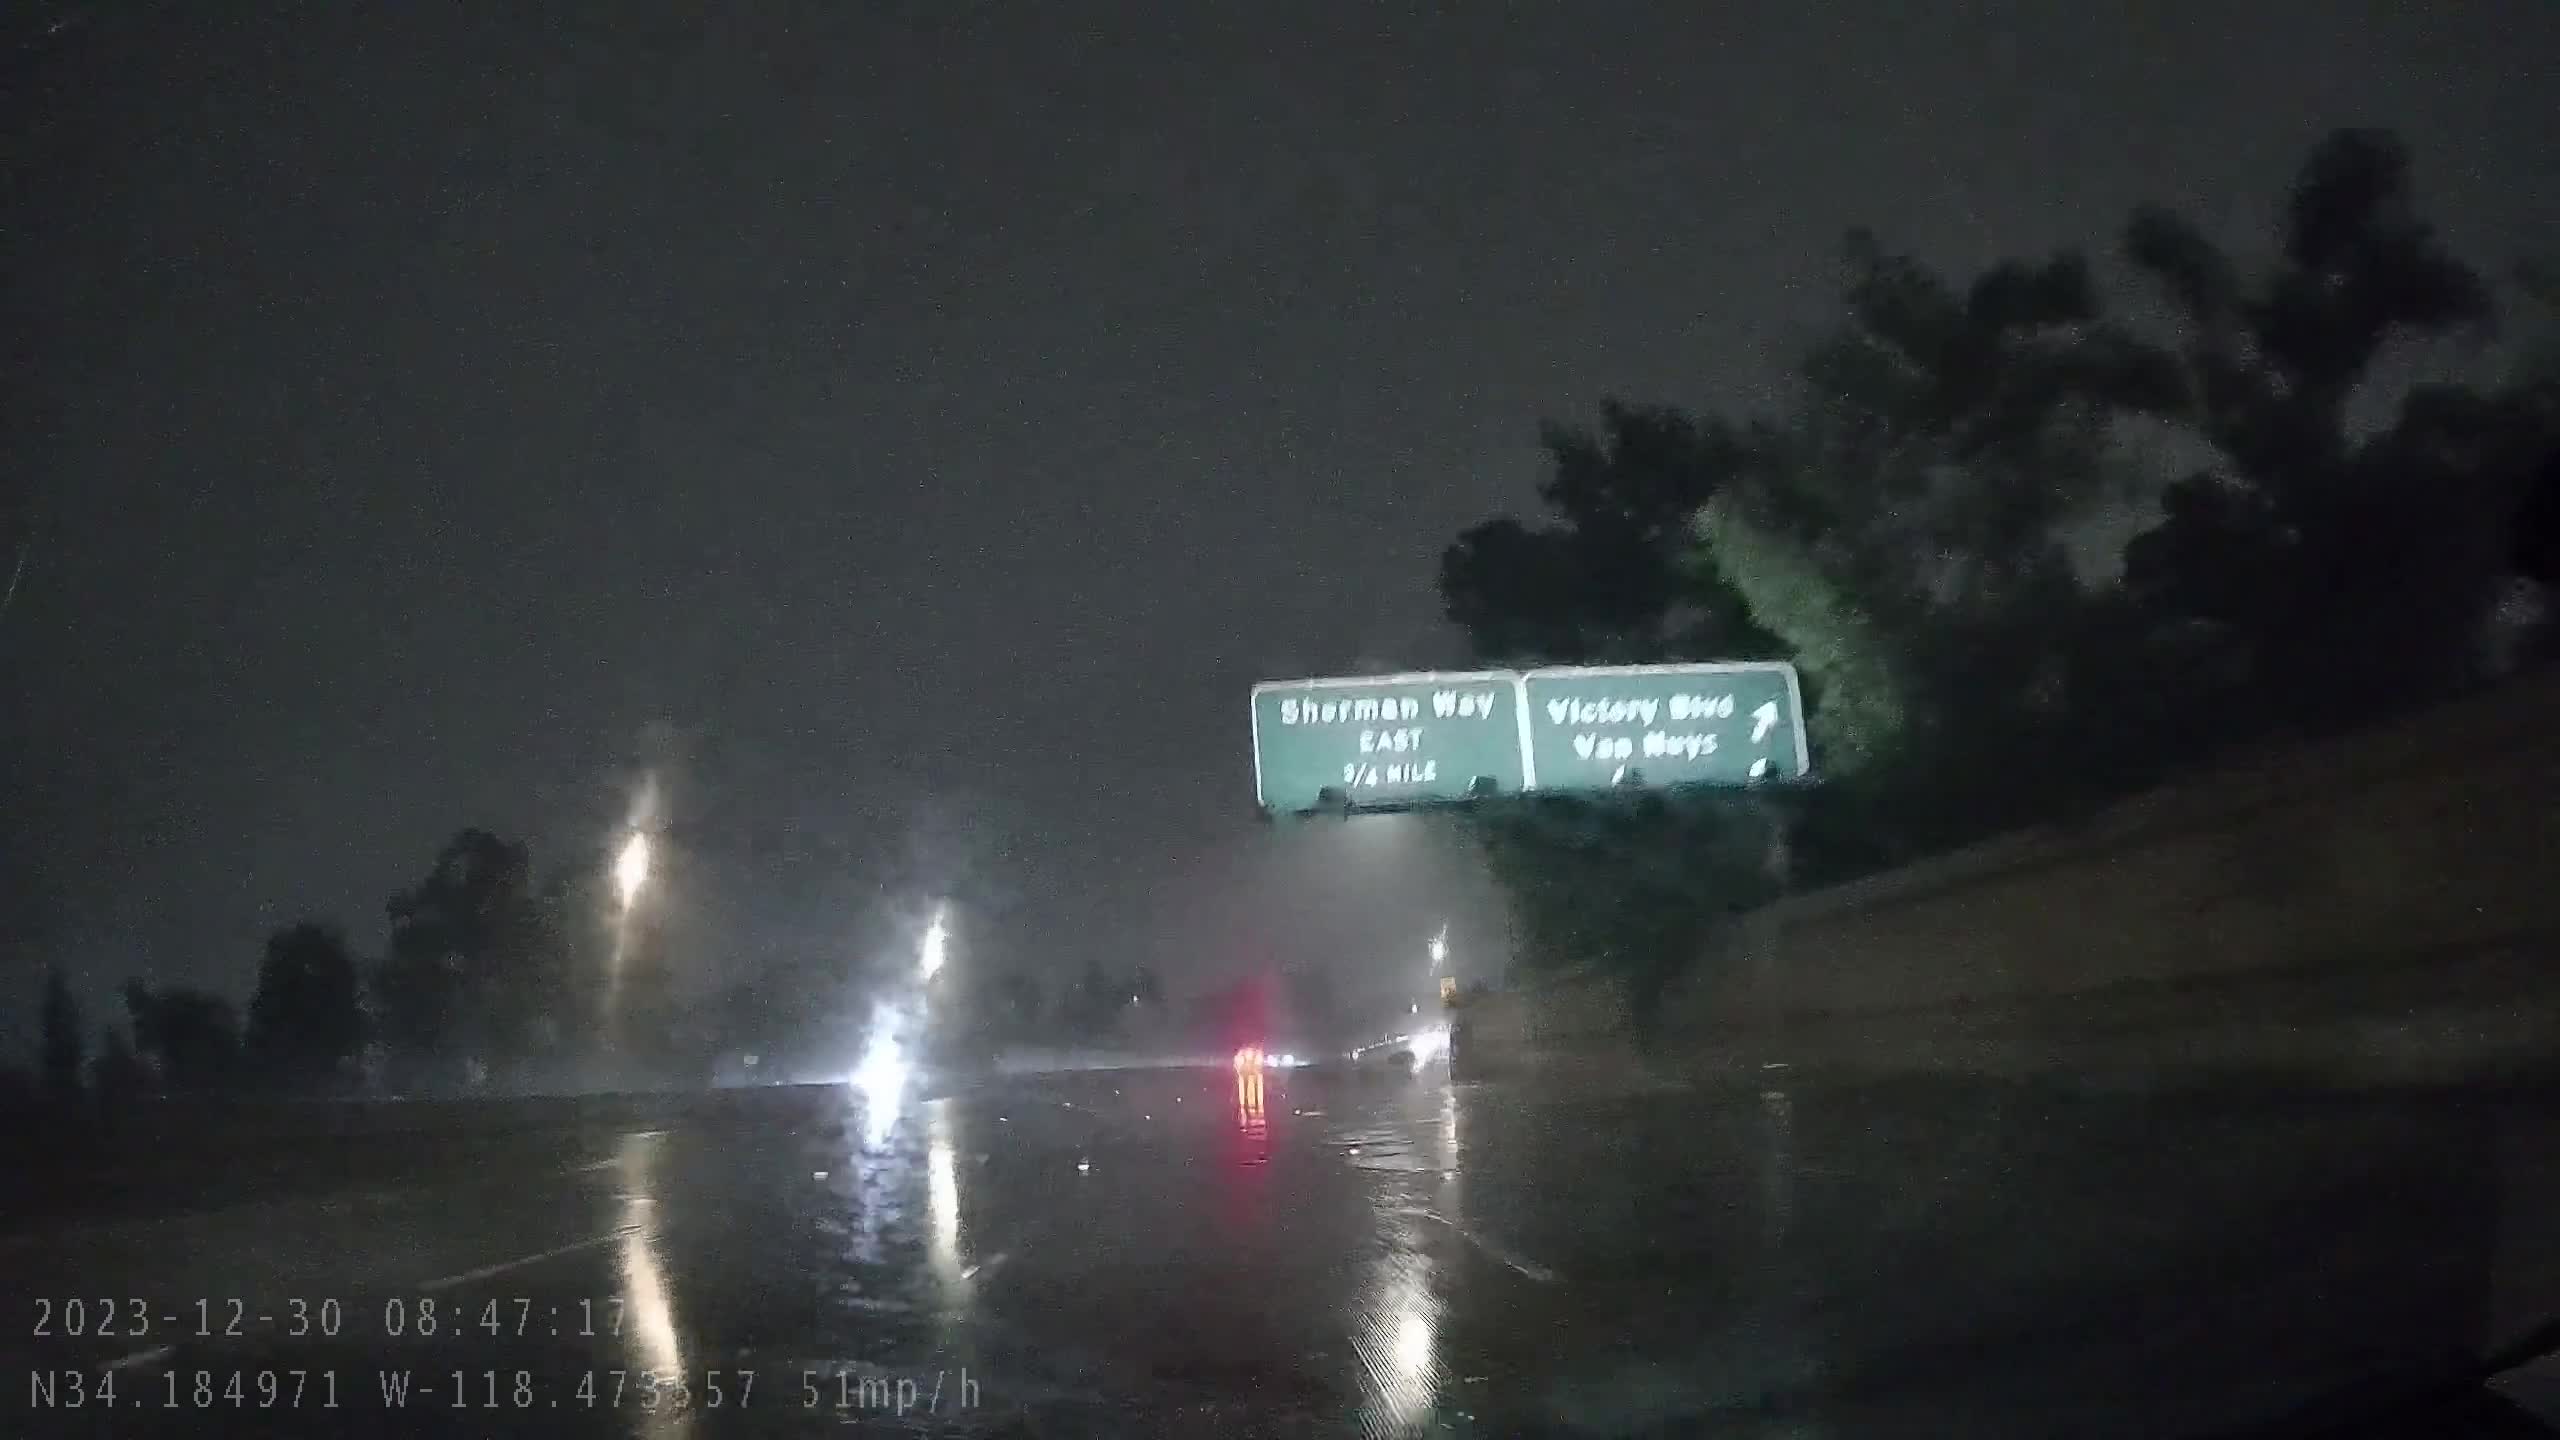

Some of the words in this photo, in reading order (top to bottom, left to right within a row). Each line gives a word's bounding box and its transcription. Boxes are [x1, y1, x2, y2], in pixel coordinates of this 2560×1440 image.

[1281, 696, 1419, 724] Sherman
[1432, 689, 1495, 720] Way
[1547, 695, 1659, 727] Victory
[1669, 693, 1735, 720] Blvd
[1360, 728, 1424, 752] EAST
[1573, 732, 1632, 760] Van
[1642, 730, 1718, 761] Nuys
[1343, 762, 1378, 789] 3/4
[1387, 760, 1437, 784] MILE
